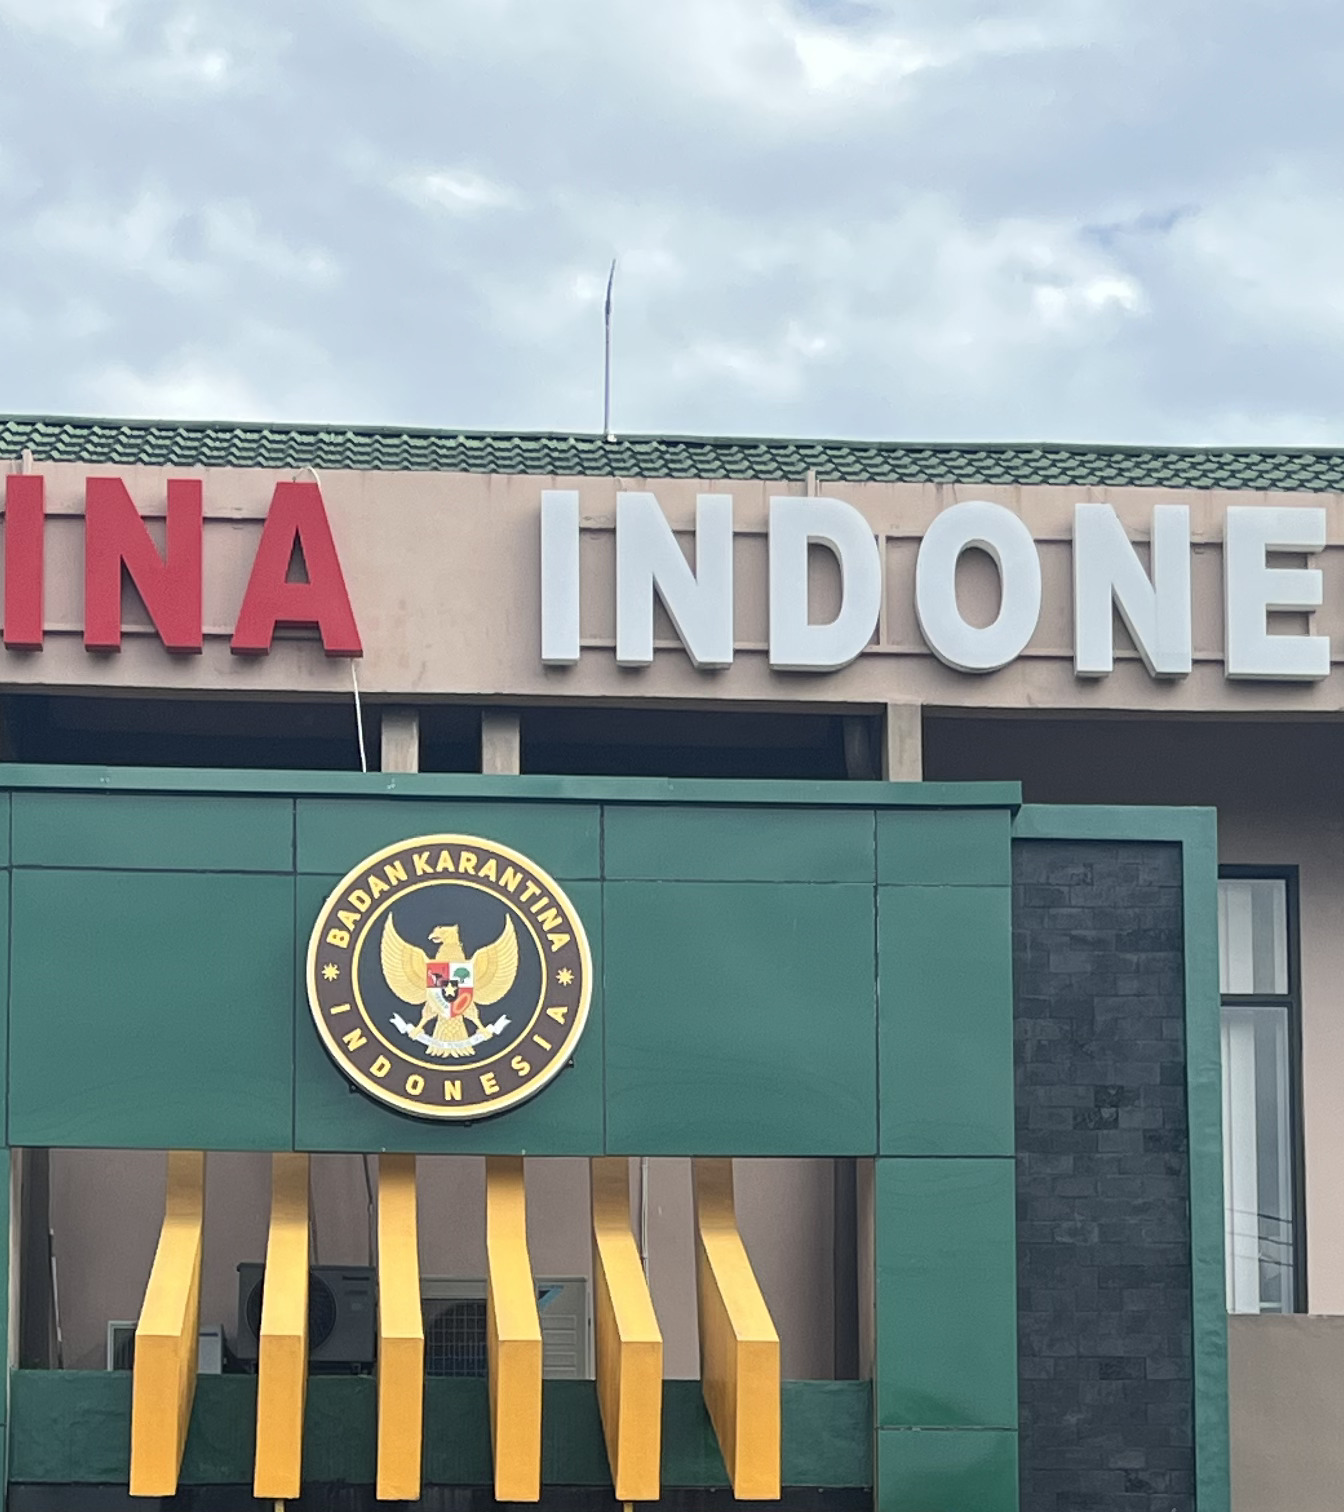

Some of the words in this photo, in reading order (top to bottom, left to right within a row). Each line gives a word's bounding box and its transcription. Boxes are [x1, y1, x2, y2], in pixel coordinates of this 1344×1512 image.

[326, 860, 408, 949] BADAN
[412, 850, 571, 952] KARANTINA
[330, 1003, 569, 1101] INDONESIA
